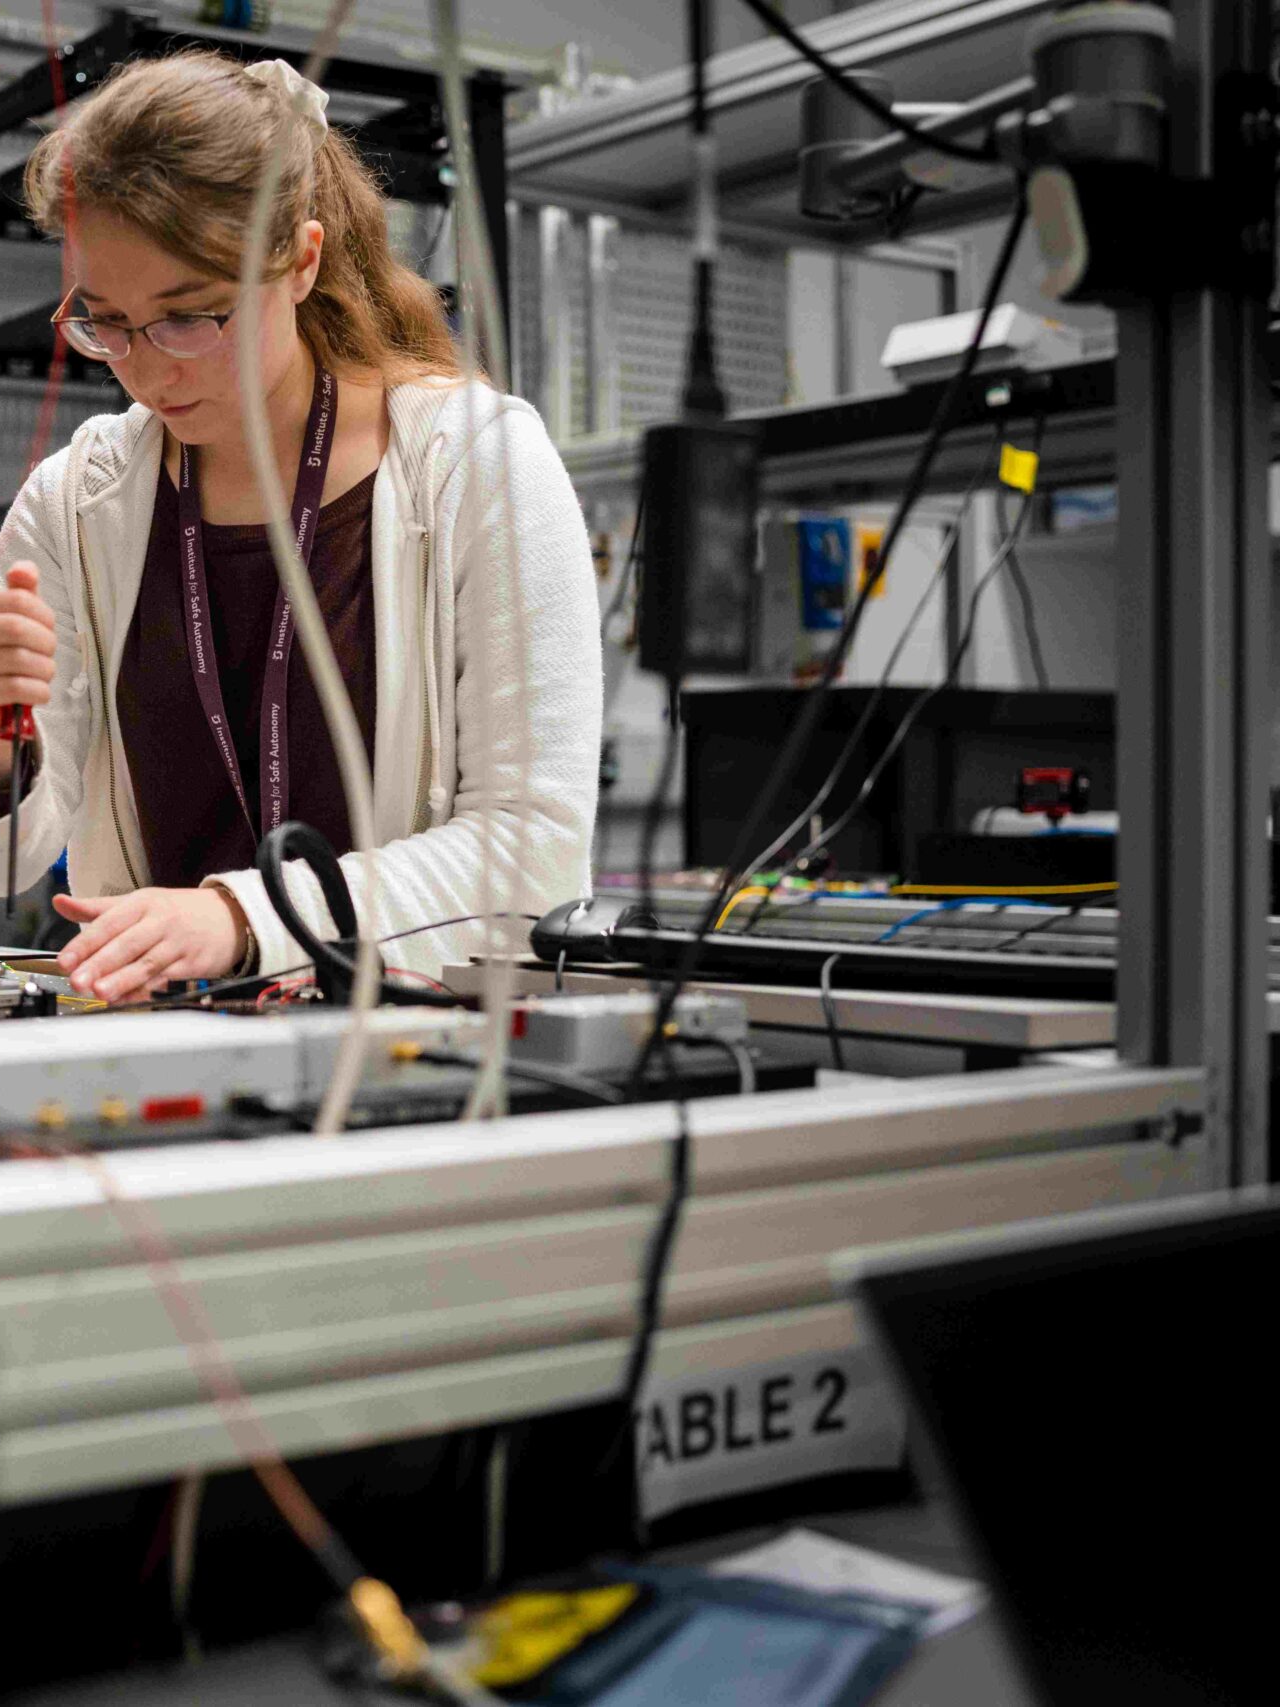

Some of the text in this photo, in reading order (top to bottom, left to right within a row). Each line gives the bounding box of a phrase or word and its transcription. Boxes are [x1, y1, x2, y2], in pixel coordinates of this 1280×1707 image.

[311, 374, 332, 455] Institute for Safe
[293, 507, 312, 560] Autonomy
[186, 538, 207, 674] Institute for Safe Autonomy
[275, 603, 291, 648] Institute
[269, 703, 280, 758] Autonomy
[269, 760, 280, 783] Safe
[270, 784, 282, 799] for
[637, 1366, 848, 1463] ABLE 2
